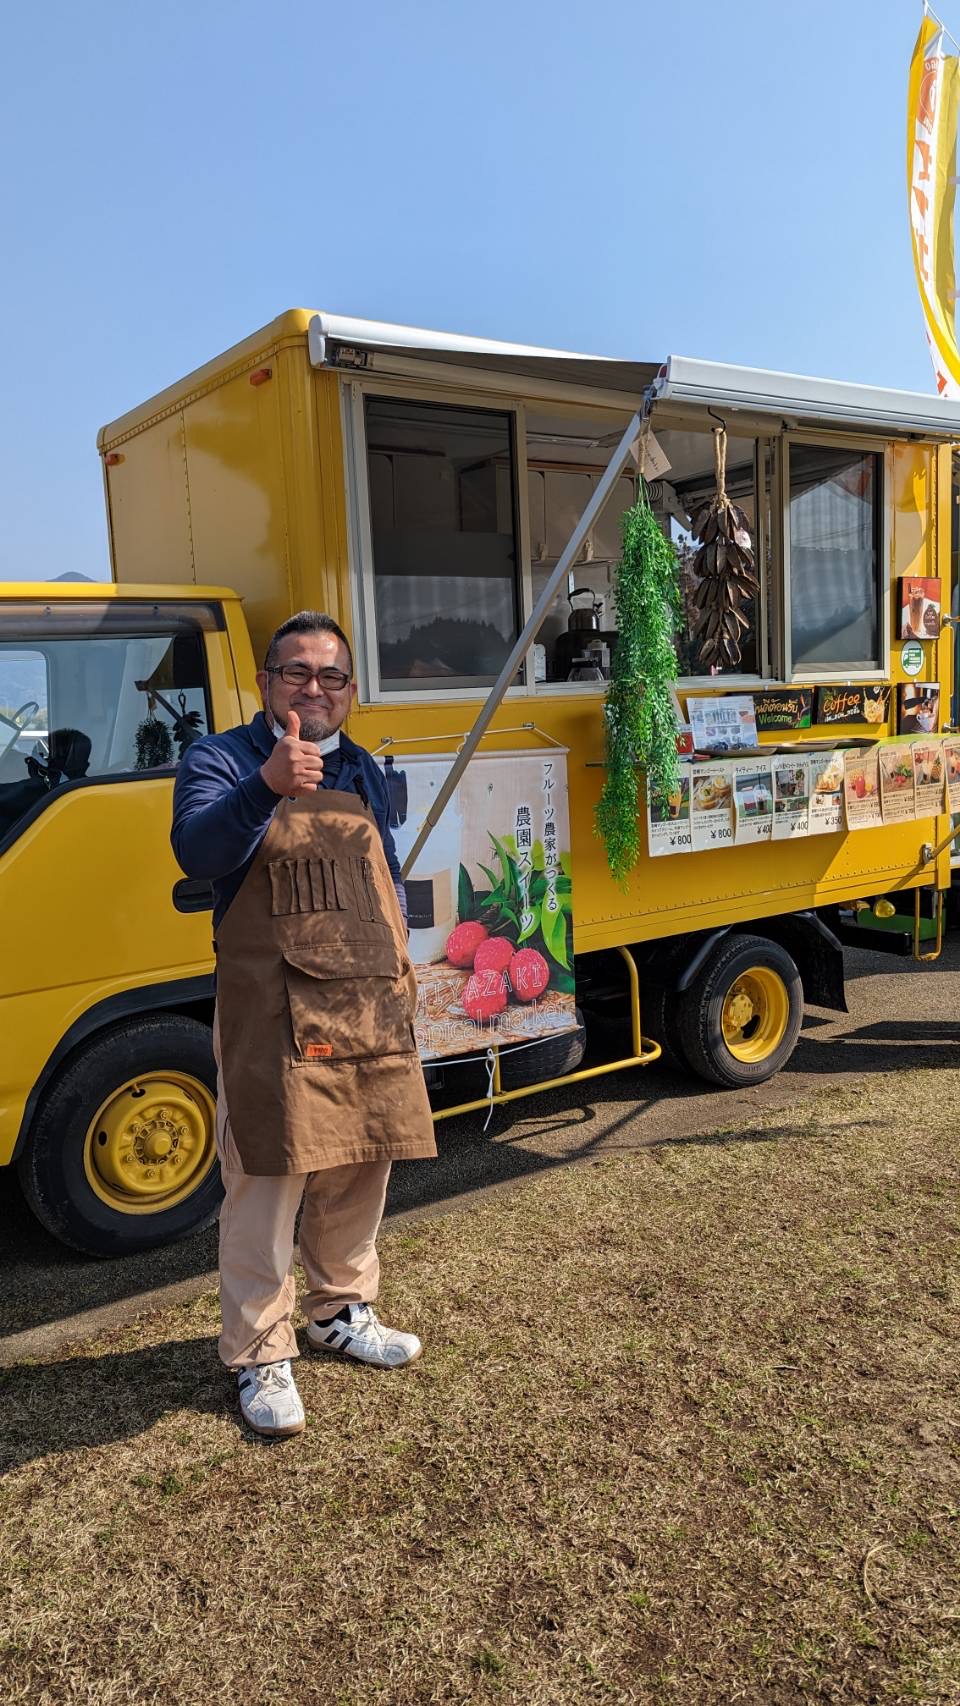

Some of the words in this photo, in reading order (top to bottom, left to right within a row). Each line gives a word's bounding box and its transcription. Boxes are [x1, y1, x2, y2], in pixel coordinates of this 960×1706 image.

[759, 713, 793, 725] Welcome
[515, 806, 535, 933] 農園スイーツ
[543, 762, 559, 913] フルーツ農家がつくる
